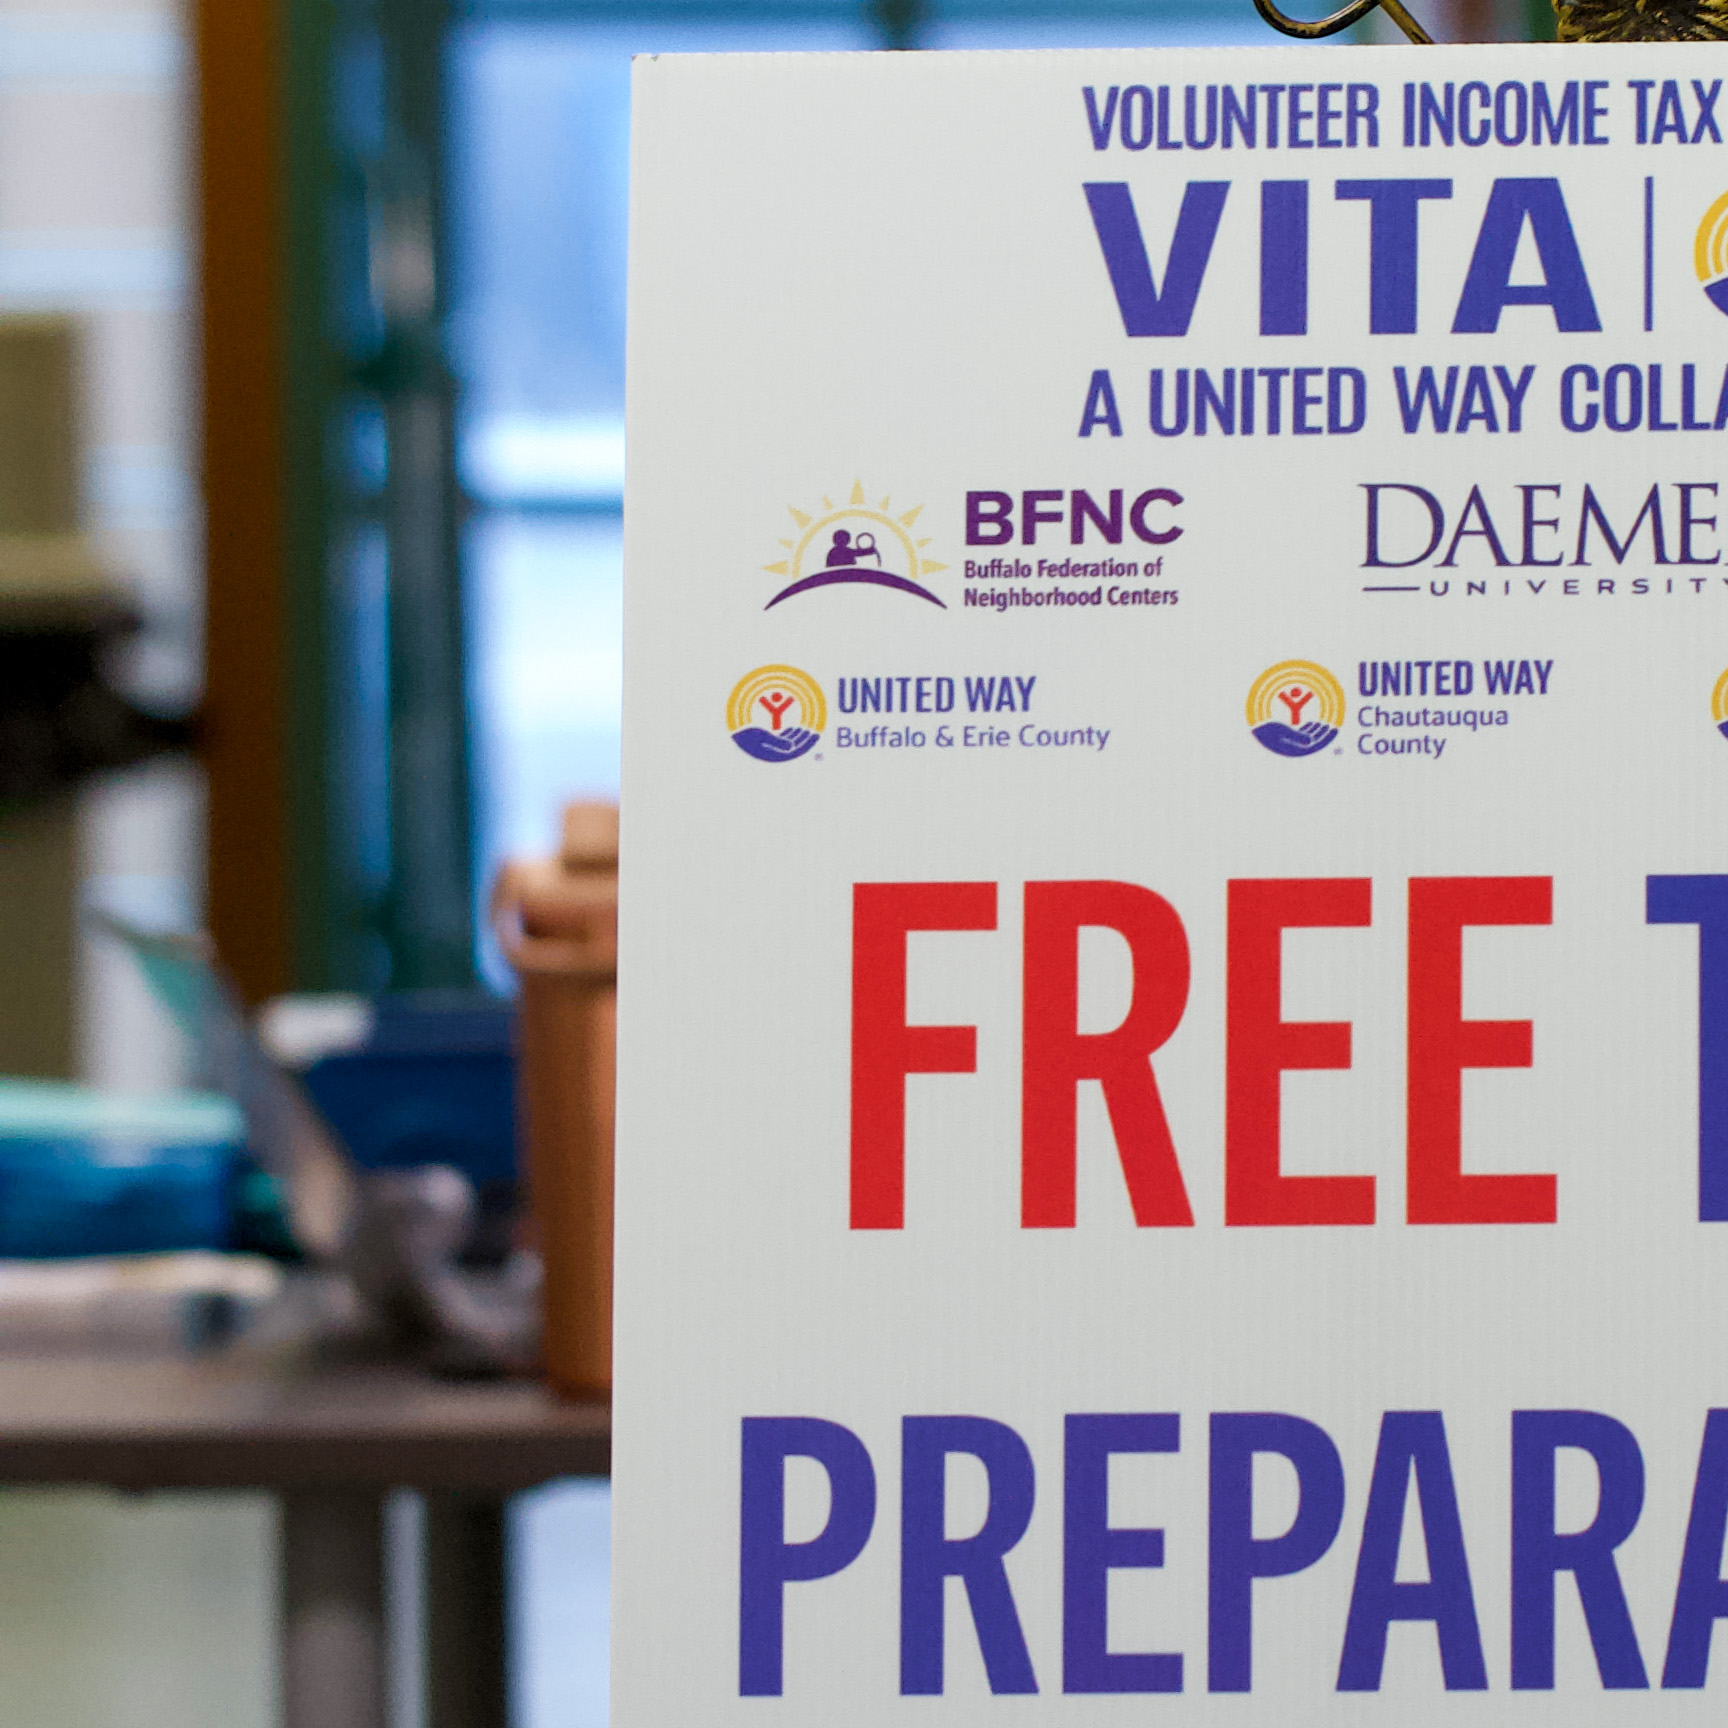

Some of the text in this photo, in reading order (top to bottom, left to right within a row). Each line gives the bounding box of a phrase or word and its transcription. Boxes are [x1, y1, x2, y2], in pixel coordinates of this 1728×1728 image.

[1081, 82, 1380, 152] VOLUNTEER
[1402, 79, 1610, 148] INCOME
[1626, 78, 1724, 146] TAX
[1081, 175, 1604, 339] VITA
[1077, 368, 1124, 438] A
[1148, 366, 1368, 438] UNITED
[1392, 364, 1537, 435] WAY
[964, 487, 1185, 547] BFNC
[963, 555, 1164, 580] Buffalo Federation of
[963, 585, 1179, 613] Neighborhood Centers
[837, 675, 1037, 714] UNITED WAY
[1358, 659, 1554, 698] UNITED WAY
[836, 723, 1112, 752] Buffalo & Erie County
[1357, 705, 1509, 733] Chautauqua
[1357, 733, 1447, 760] County
[848, 875, 1558, 1231] FREE
